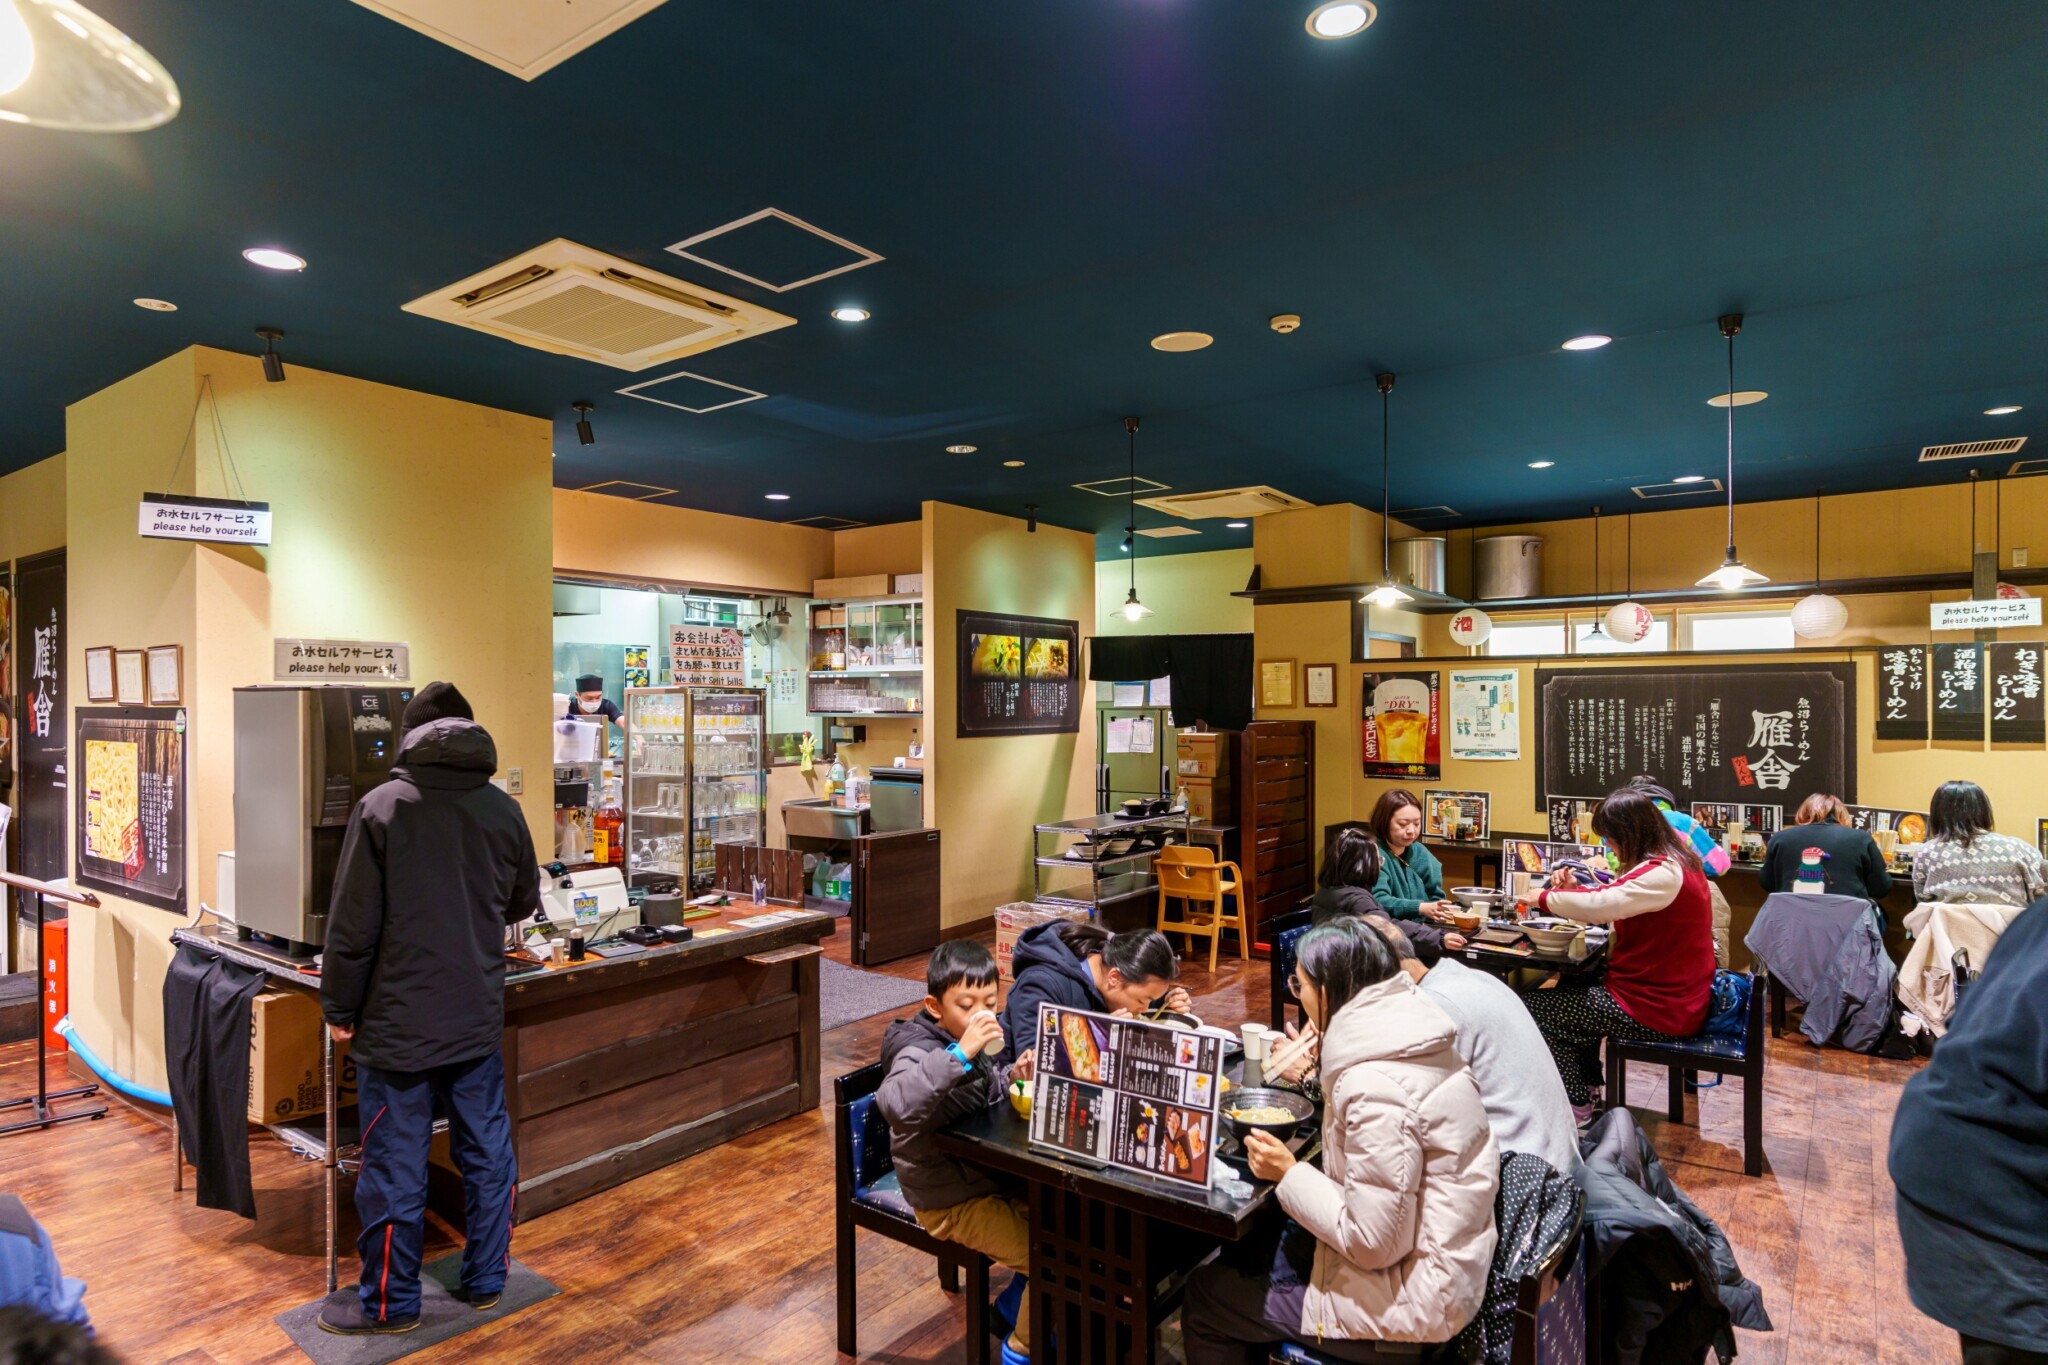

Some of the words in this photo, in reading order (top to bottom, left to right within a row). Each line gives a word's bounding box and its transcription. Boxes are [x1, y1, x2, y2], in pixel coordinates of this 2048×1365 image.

[157, 509, 255, 524] お水セルフサービス
[153, 522, 187, 532] please
[190, 524, 212, 534] help
[215, 528, 258, 536] yourself
[1944, 604, 2026, 616] お水セルフサービス
[1992, 614, 2030, 622] yourself
[1454, 616, 1472, 632] 酒
[1634, 606, 1654, 642] 餃子
[675, 630, 721, 645] お会計は
[292, 646, 394, 658] お水セルフサービス
[676, 646, 741, 658] まとめてお支払い
[289, 662, 324, 674] please
[328, 663, 350, 674] help
[354, 664, 398, 674] yourslf
[1908, 648, 1923, 690] からいすけ
[1954, 648, 1978, 691] 酒粕味噌
[2012, 648, 2042, 698] ねぎ味噌
[674, 673, 686, 682] We
[689, 674, 706, 684] don't
[727, 676, 743, 686] bills
[1883, 650, 1910, 719] 味噌らーめん
[1938, 671, 1958, 709] らーめん
[1994, 674, 2017, 720] らーめん
[362, 698, 379, 708] ICE
[1696, 714, 1706, 772] 雪国の雁木から
[1747, 709, 1800, 790] 雁舎
[1682, 736, 1692, 789] 連想した名前。
